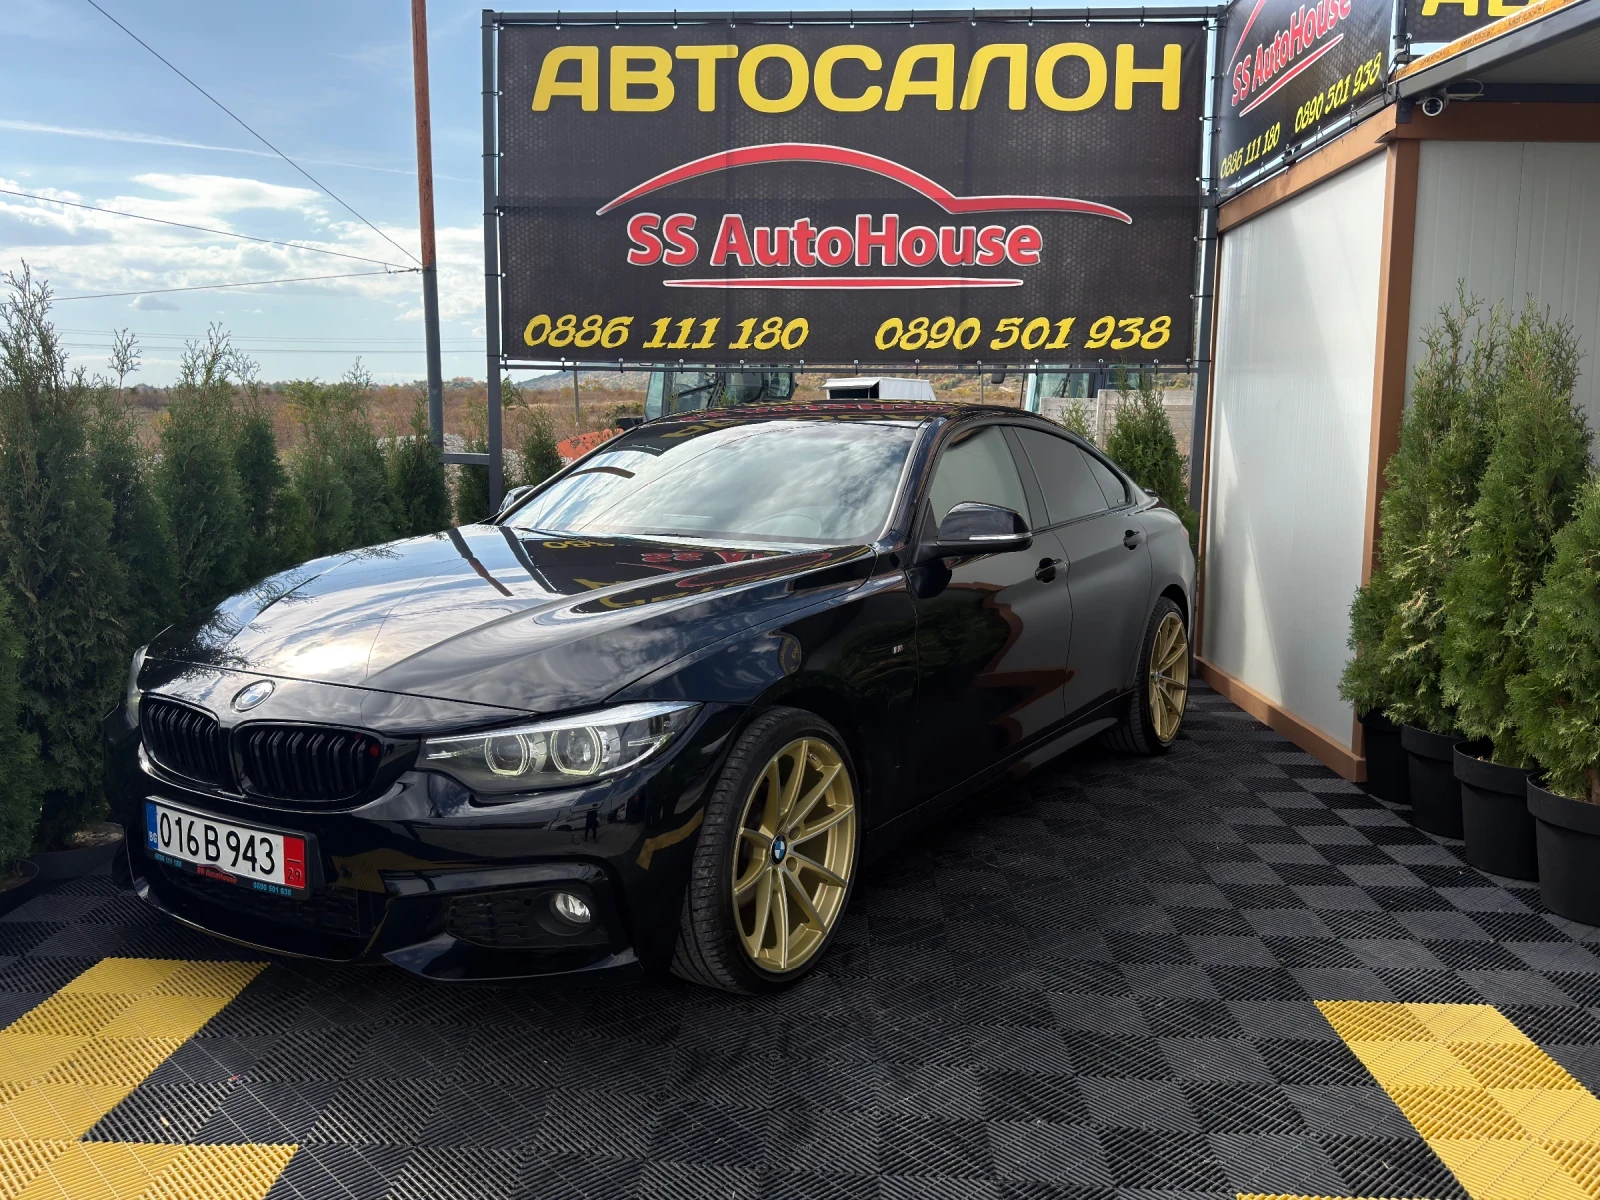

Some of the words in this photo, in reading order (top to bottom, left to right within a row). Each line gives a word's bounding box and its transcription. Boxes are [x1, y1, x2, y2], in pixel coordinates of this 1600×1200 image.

[531, 41, 1182, 114] АВТОСАЛОН
[1231, 54, 1251, 106] SS
[1252, 0, 1351, 92] AutoHouse
[1295, 93, 1324, 133] 0890
[1325, 75, 1352, 114] 501
[1352, 52, 1382, 97] 938
[1220, 150, 1243, 180] 0886
[1244, 135, 1262, 166] 111
[1262, 122, 1281, 155] 180
[627, 212, 699, 267] SS
[711, 213, 1043, 267] AutoHouse
[523, 314, 634, 348] 0886
[642, 317, 721, 350] 111
[728, 316, 810, 350] 180
[874, 316, 982, 351] 0890
[989, 317, 1076, 351] 501
[1083, 315, 1172, 350] 938
[148, 831, 158, 844] BG
[287, 867, 302, 882] 29
